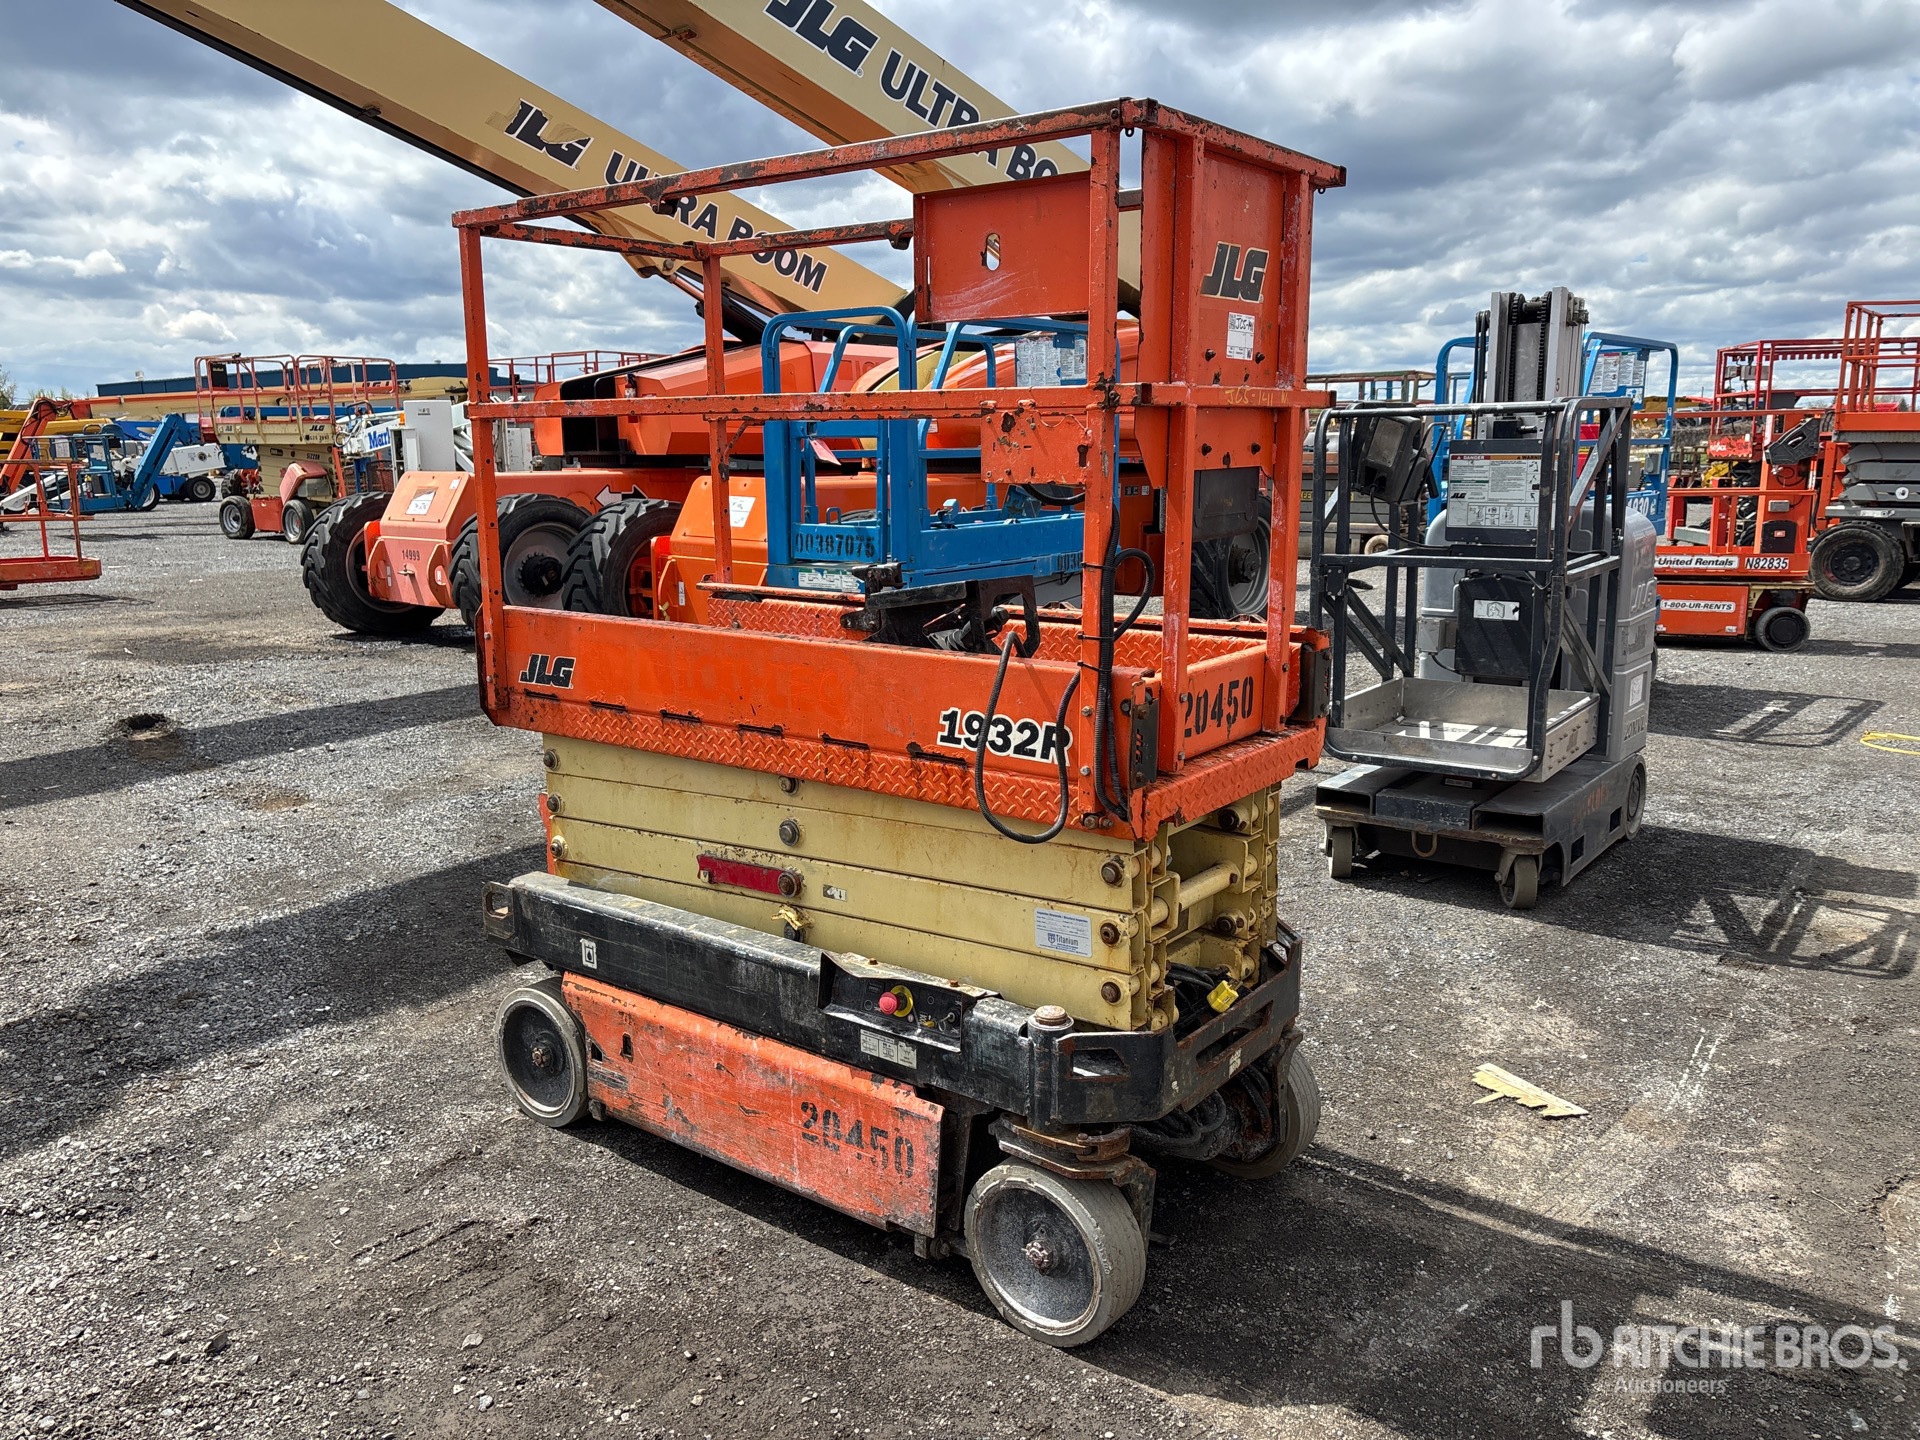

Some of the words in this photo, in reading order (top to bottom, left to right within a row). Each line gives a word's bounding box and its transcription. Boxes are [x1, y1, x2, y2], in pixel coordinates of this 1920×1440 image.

[1200, 240, 1270, 304] JLG
[402, 549, 420, 561] 14999
[1658, 556, 1692, 566] United
[1694, 557, 1734, 567] Rentals
[1745, 557, 1788, 570] N82835
[1663, 602, 1733, 611] 1-800-UR-RENTS
[518, 652, 577, 689] JLG
[1184, 676, 1254, 738] 20450
[937, 707, 1073, 766] 1932R
[1056, 934, 1079, 947] Titanium
[801, 1101, 914, 1178] 20450
